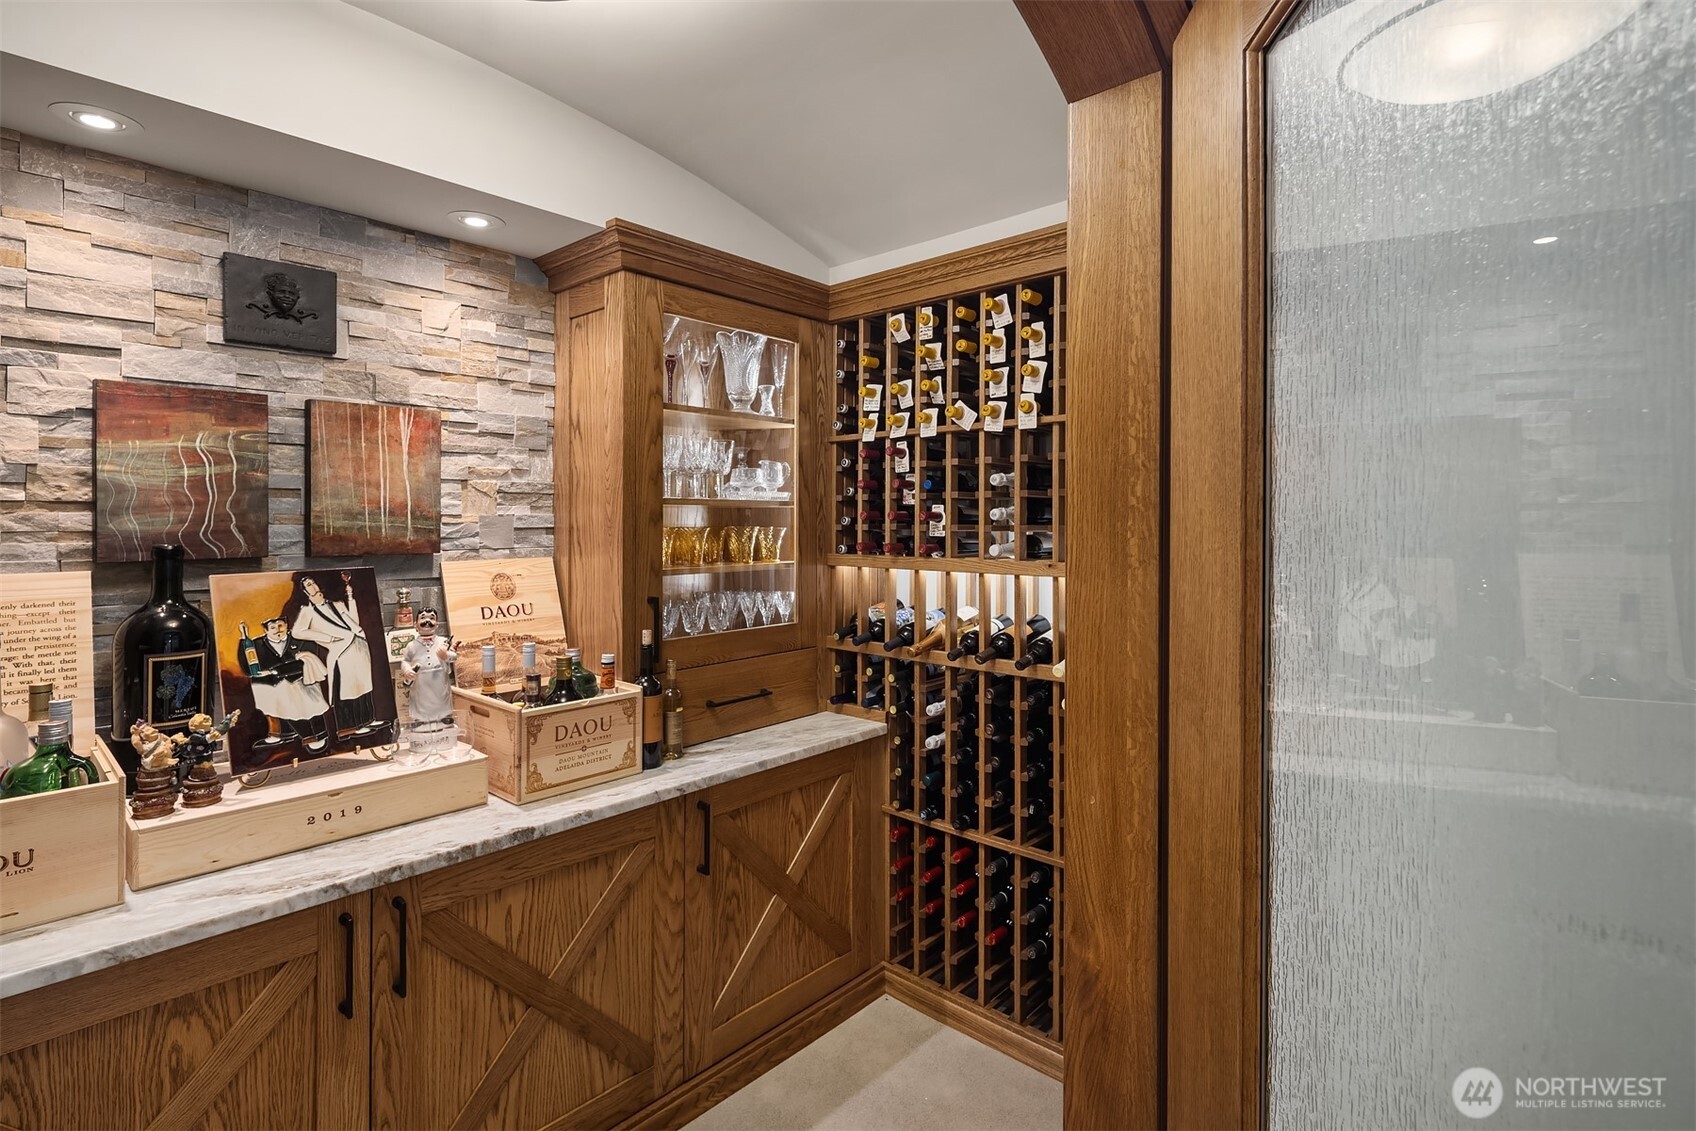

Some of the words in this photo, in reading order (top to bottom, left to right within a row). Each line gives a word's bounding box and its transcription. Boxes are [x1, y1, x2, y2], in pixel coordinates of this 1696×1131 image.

[481, 602, 533, 620] DAOU
[19, 618, 57, 626] Embattled
[555, 716, 613, 742] DAOU
[555, 740, 585, 750] VINEYARDS
[555, 761, 584, 772] ADELAIDA
[586, 754, 612, 766] DISTRICT
[559, 756, 576, 764] DAOU
[578, 748, 609, 760] MOUNTAIN
[6, 866, 34, 876] LION
